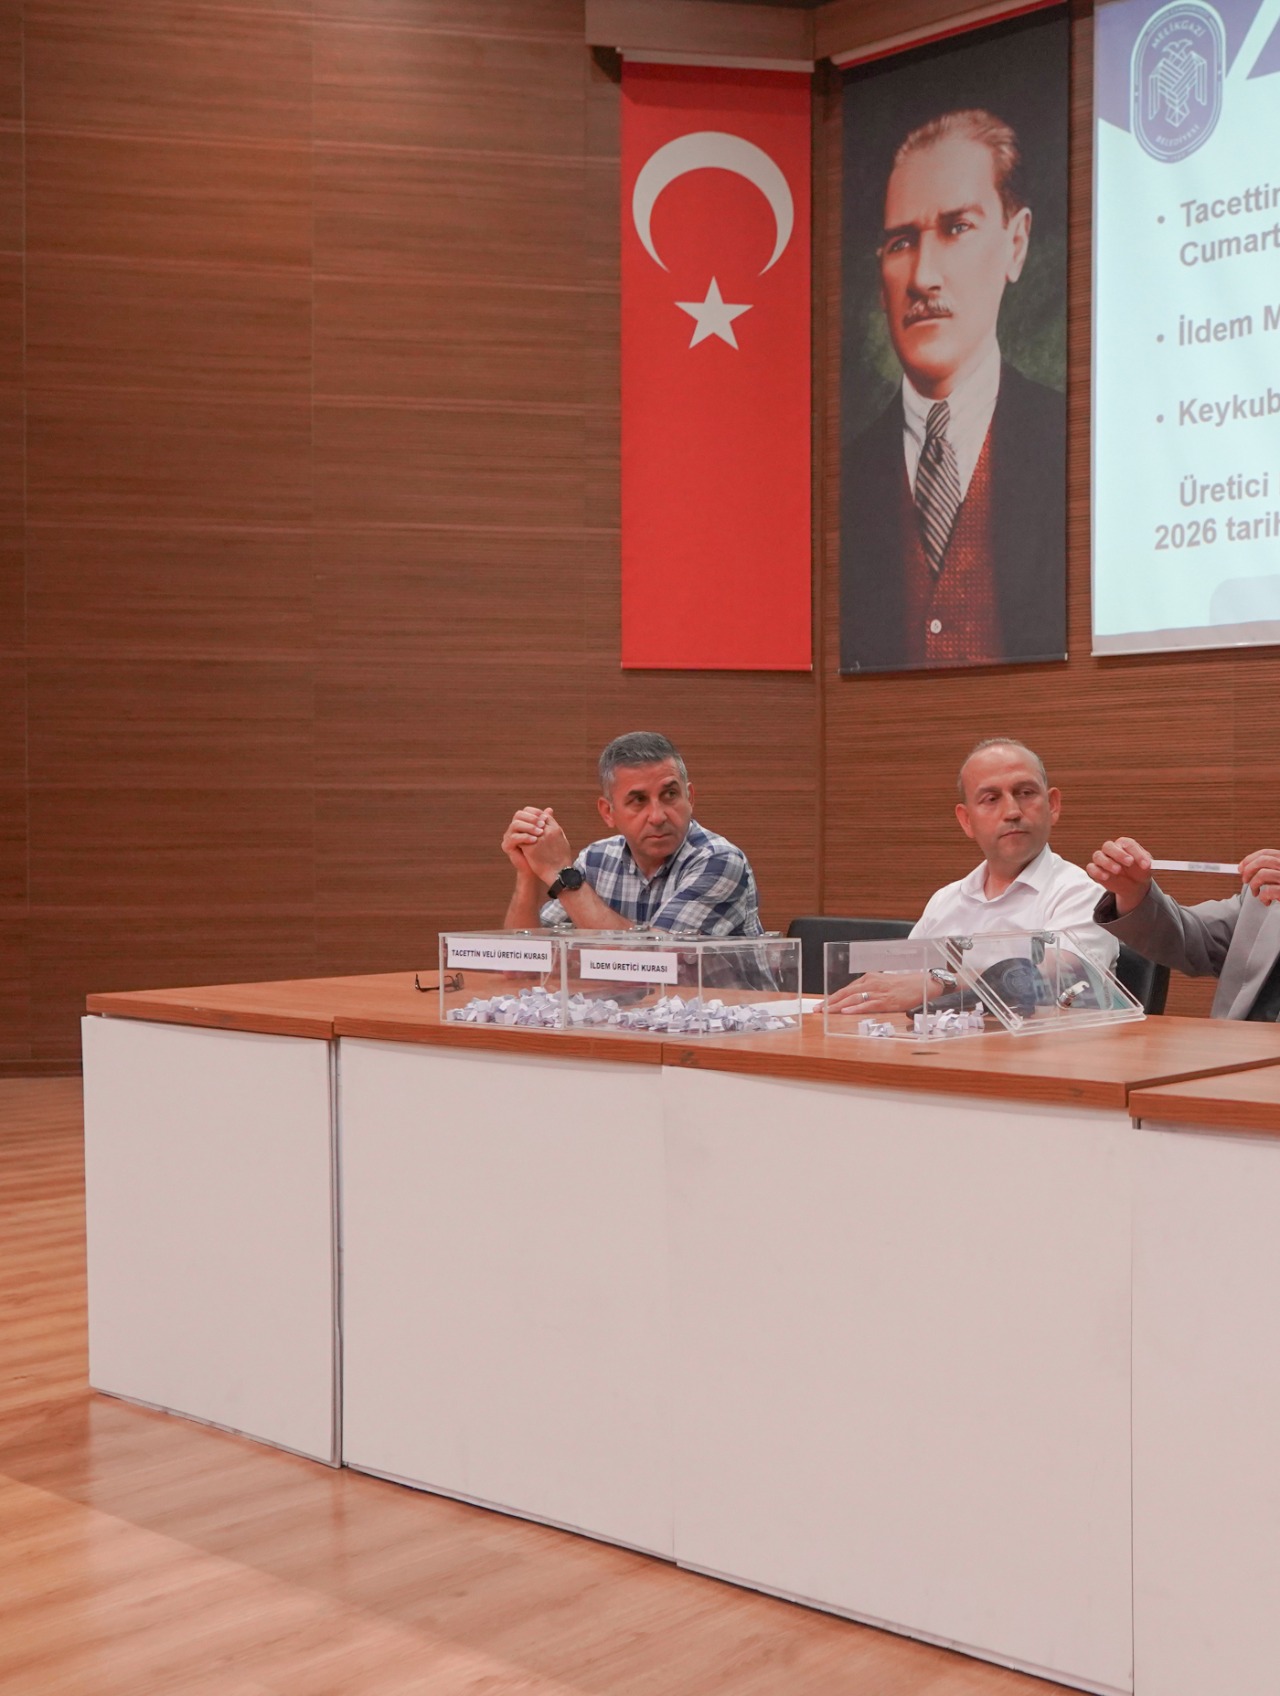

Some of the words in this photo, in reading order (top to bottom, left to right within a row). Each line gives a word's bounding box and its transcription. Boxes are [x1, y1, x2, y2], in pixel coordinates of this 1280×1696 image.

[1178, 314, 1253, 347] İldem
[1179, 475, 1269, 508] Üretici
[1154, 517, 1217, 551] 2026
[451, 949, 481, 957] TACETTİN
[482, 949, 495, 958] VELİ
[497, 950, 522, 959] ÜRETİCİ
[523, 952, 548, 960] KURASI
[590, 960, 611, 970] İLDEM
[612, 962, 640, 972] ÜRETİCİ
[641, 964, 668, 973] KURASI
